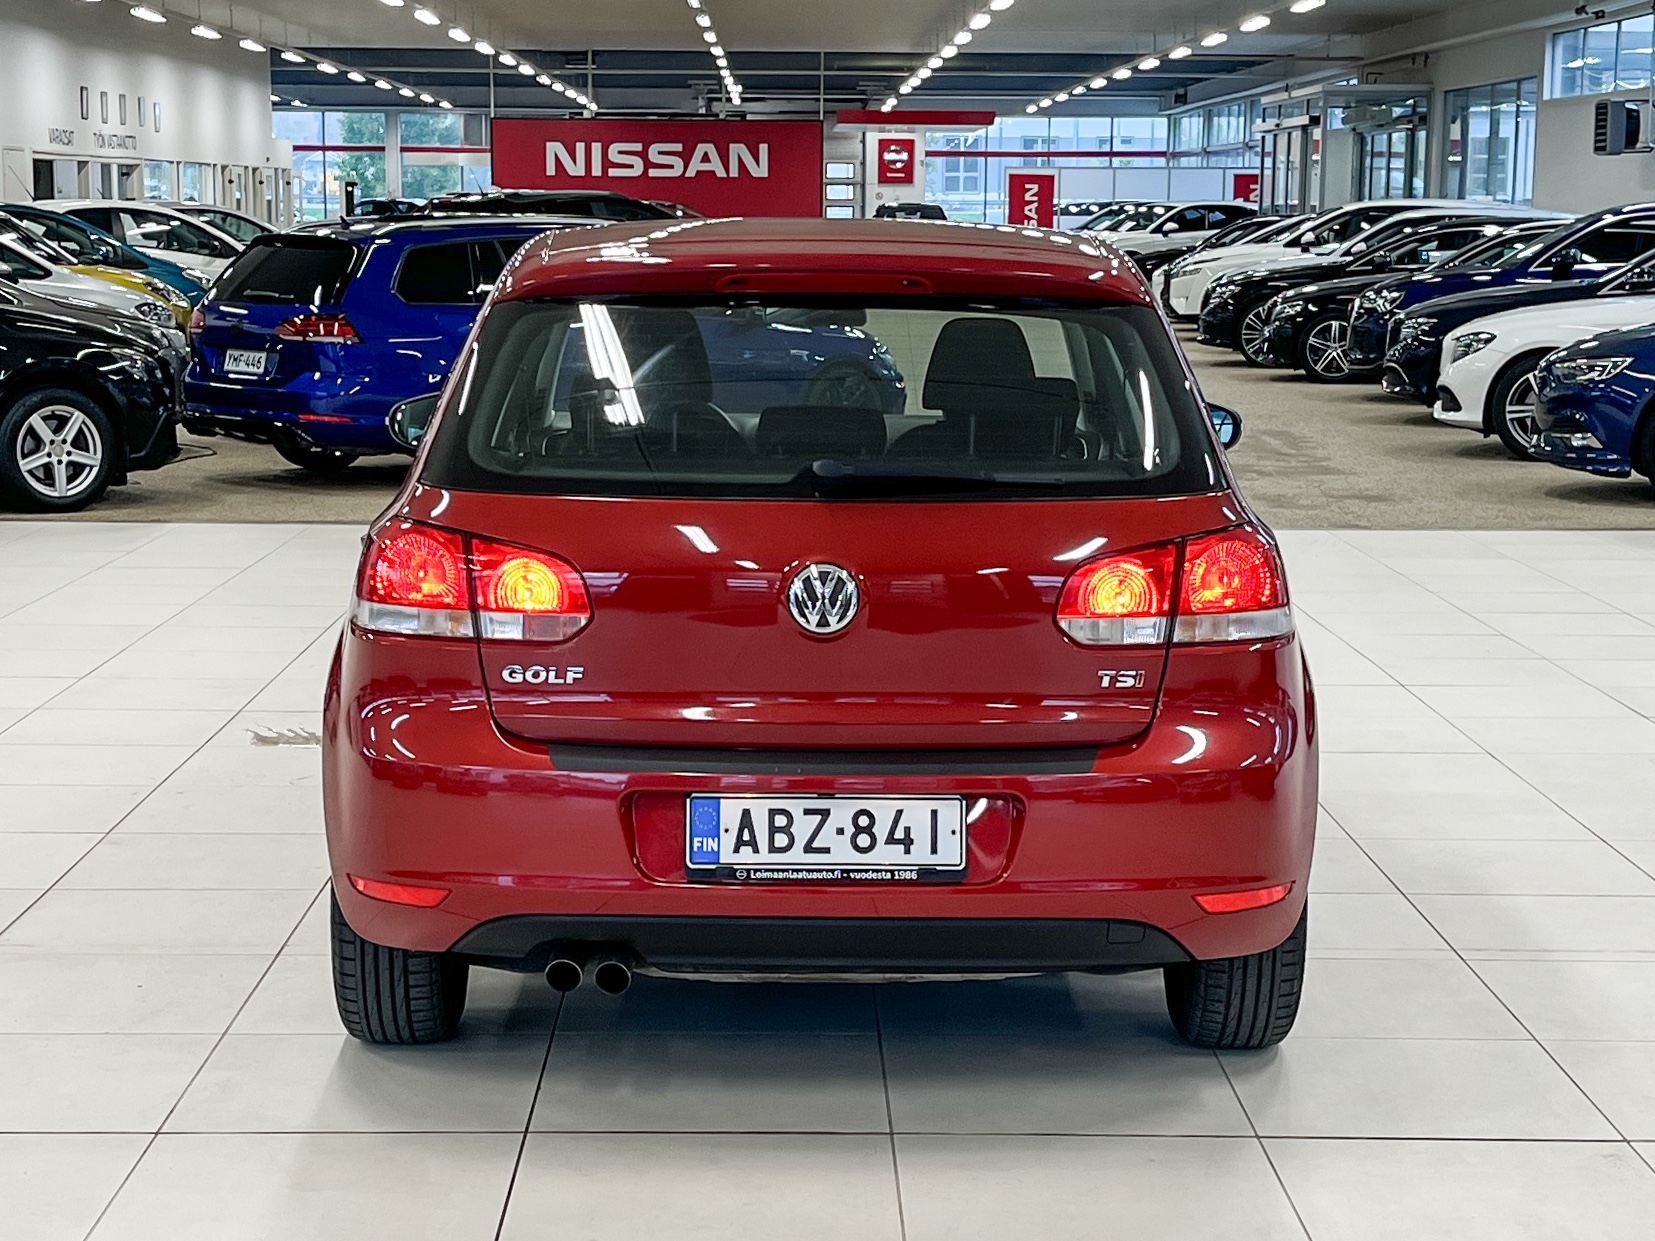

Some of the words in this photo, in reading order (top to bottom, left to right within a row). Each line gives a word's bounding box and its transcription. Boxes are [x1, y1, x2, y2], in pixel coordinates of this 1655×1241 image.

[546, 141, 769, 178] NISSAN
[501, 664, 585, 684] GOLF
[732, 808, 938, 855] ABZ-841
[693, 837, 719, 852] FIN
[750, 869, 841, 880] Loimaanlaatuauto.fi
[849, 870, 892, 880] vuodesta
[893, 870, 918, 880] 1986
